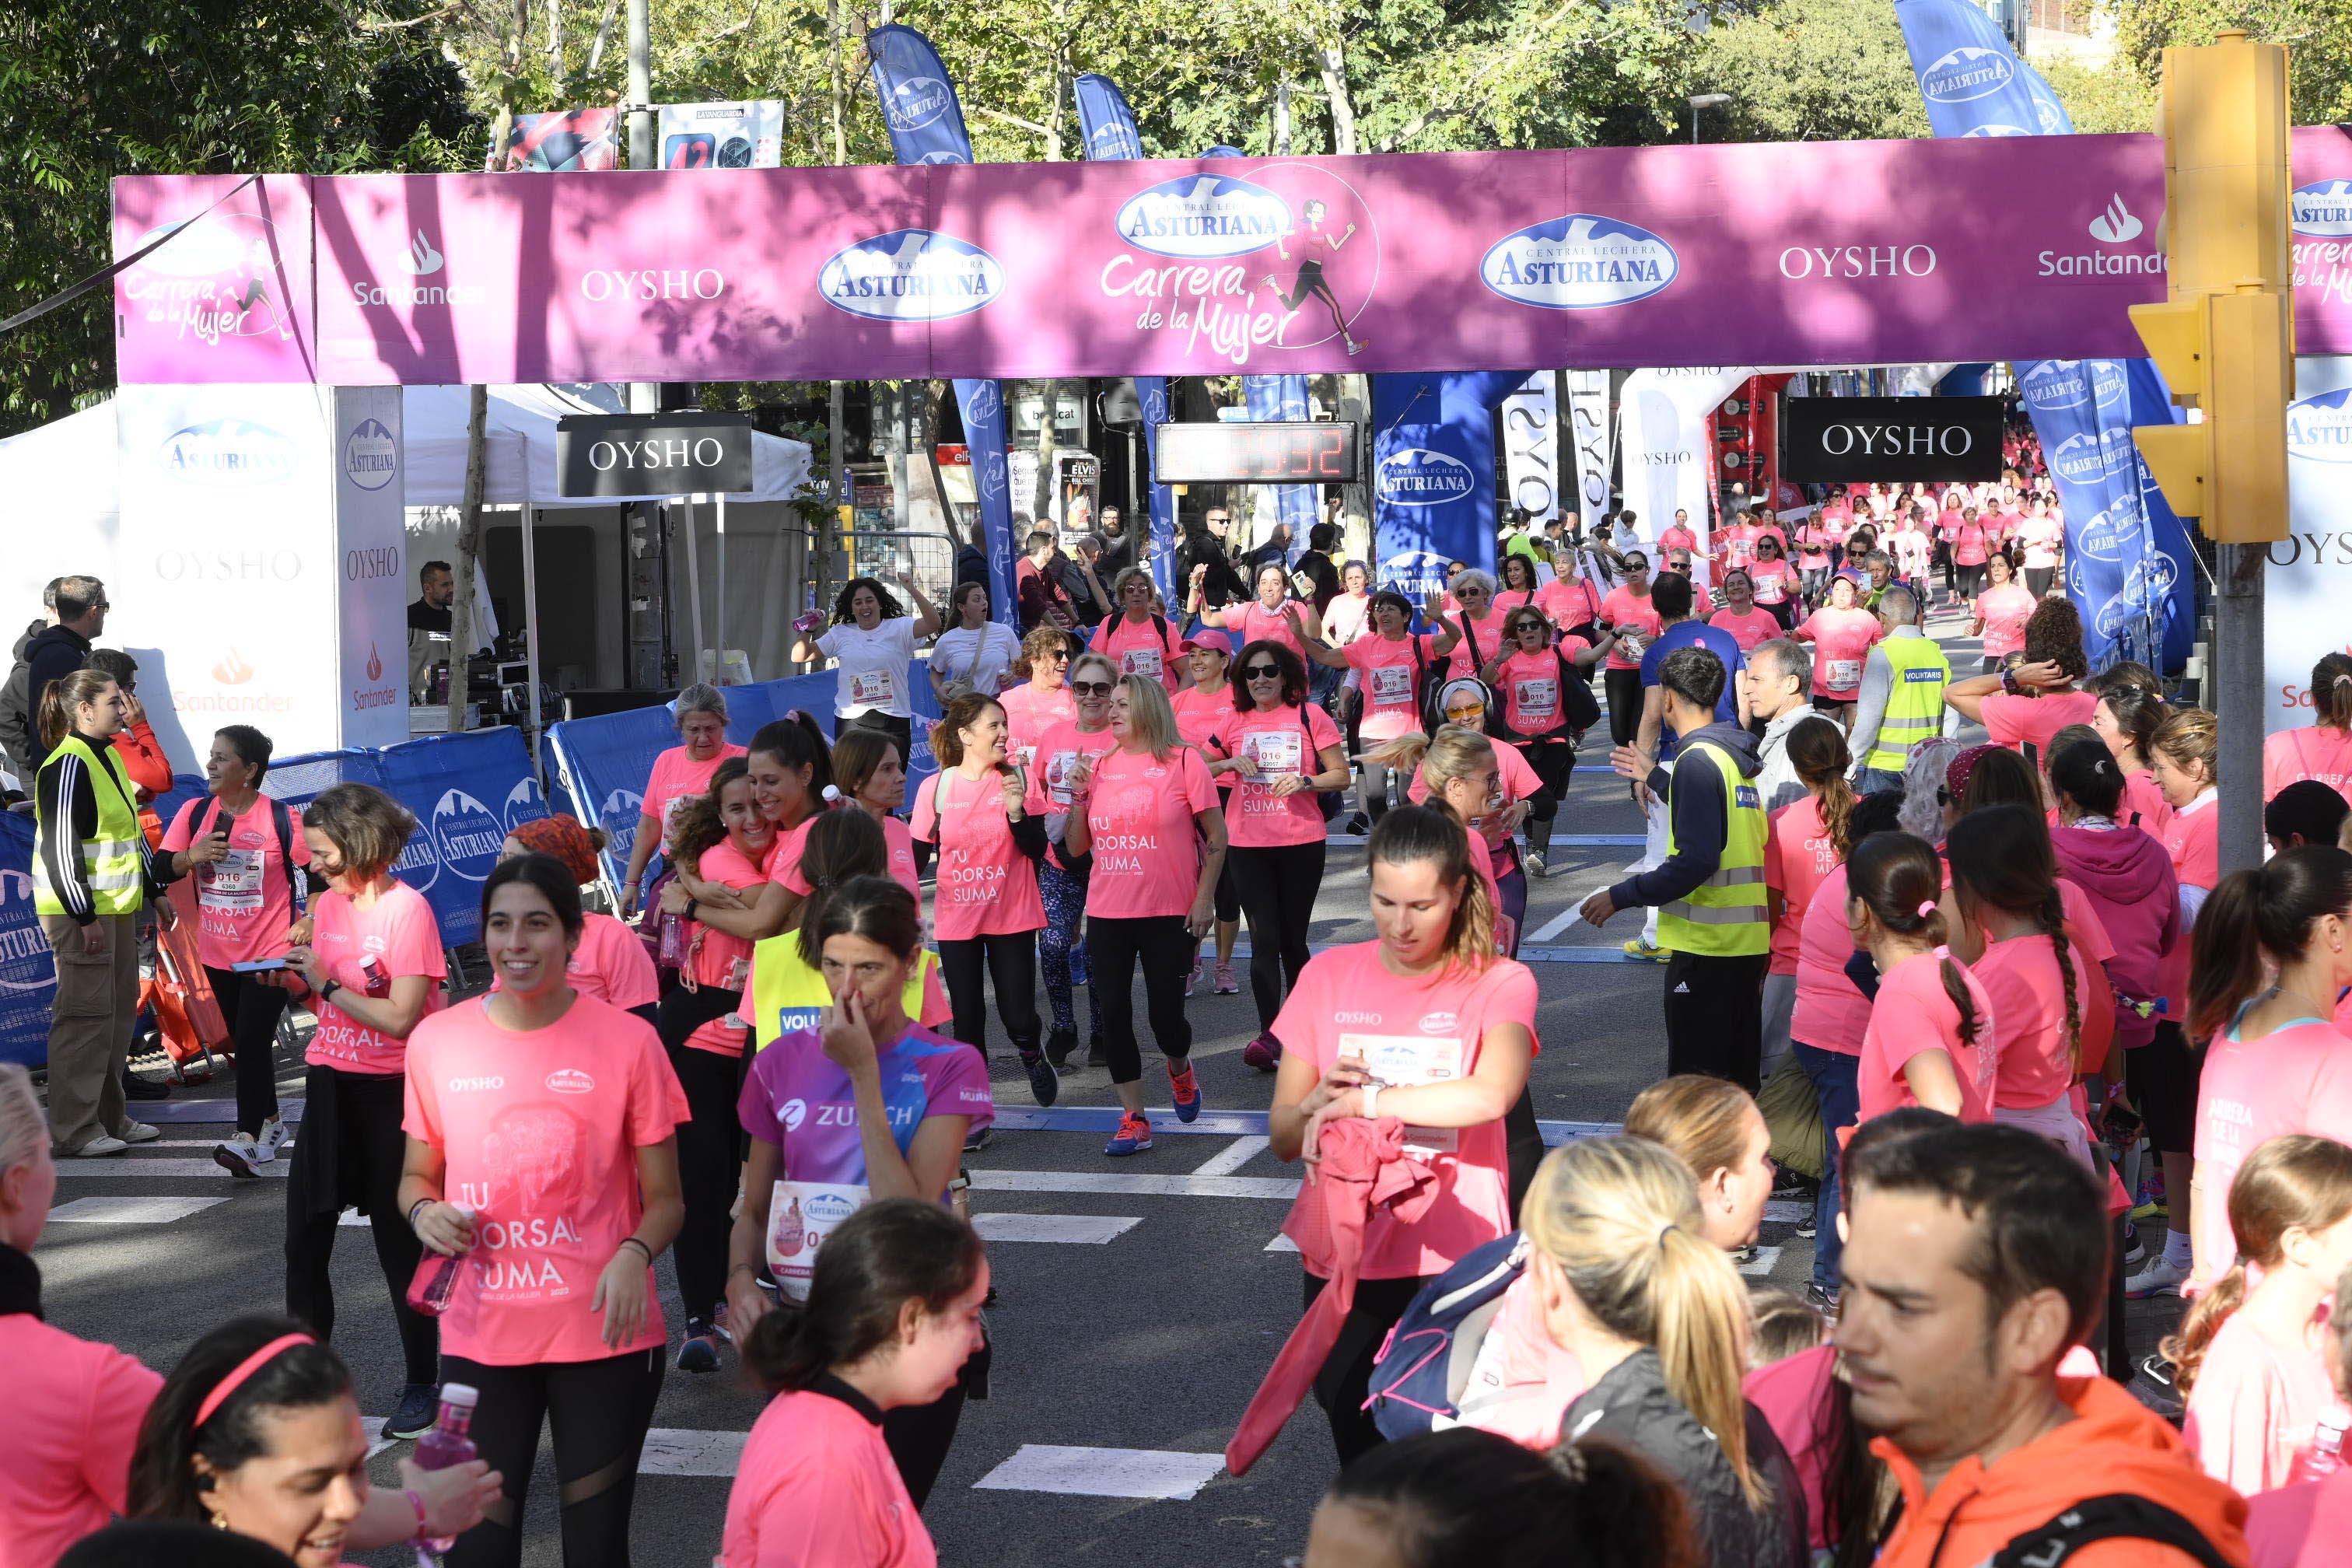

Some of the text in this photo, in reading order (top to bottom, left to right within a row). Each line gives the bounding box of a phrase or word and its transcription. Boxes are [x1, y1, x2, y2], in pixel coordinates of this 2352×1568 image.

[1129, 205, 1279, 238] ASTURIANA
[1526, 245, 1657, 258] CENTRAL LECHERA
[1496, 250, 1663, 286] ASTURIANA
[1778, 244, 1937, 279] OYSHO
[2038, 249, 2168, 277] Santand
[832, 264, 991, 298] ASTURIANA
[1101, 254, 1246, 299] Carrera
[2310, 263, 2325, 287] la
[124, 271, 216, 301] Carrera
[353, 282, 486, 306] Santander
[580, 268, 725, 302] OYSHO
[178, 301, 251, 346] Mujer
[1136, 292, 1301, 366] de la Mujer
[1822, 425, 1972, 457] OYSHO
[349, 446, 394, 473] ASTURIANA
[589, 437, 724, 471] OYSHO
[1633, 450, 1692, 466] OYSHO
[1072, 465, 1096, 475] ELVIS
[1379, 470, 1467, 494] ASTURIANA
[156, 548, 303, 582] OYSHO
[347, 547, 399, 581] OYSHO
[1389, 569, 1448, 579] CENTRAL LECH
[1458, 659, 1470, 667] TU
[173, 690, 294, 712] Santander
[353, 686, 397, 712] Santander
[1374, 707, 1403, 717] SUMA
[1517, 715, 1546, 724] SUMA
[1261, 751, 1282, 761] 016
[1244, 799, 1287, 813] SUMA
[446, 822, 467, 832] CENTRAL
[1090, 816, 1110, 831] TU
[443, 827, 504, 862] ASTURIANA
[1097, 835, 1158, 851] DORSAL
[952, 849, 968, 864] TU
[1100, 856, 1142, 870] SUMA
[1816, 851, 1832, 863] DE
[217, 873, 240, 882] 016
[954, 886, 998, 902] SUMA
[320, 931, 348, 943] OYSHO
[320, 1001, 337, 1018] TU
[1335, 1010, 1382, 1027] OYSHO
[449, 1076, 504, 1092] OYSHO
[816, 1104, 913, 1127] ZUCH
[1409, 1132, 1448, 1143] Santander
[460, 1181, 488, 1210] TU
[807, 1204, 852, 1216] ASTURIANA
